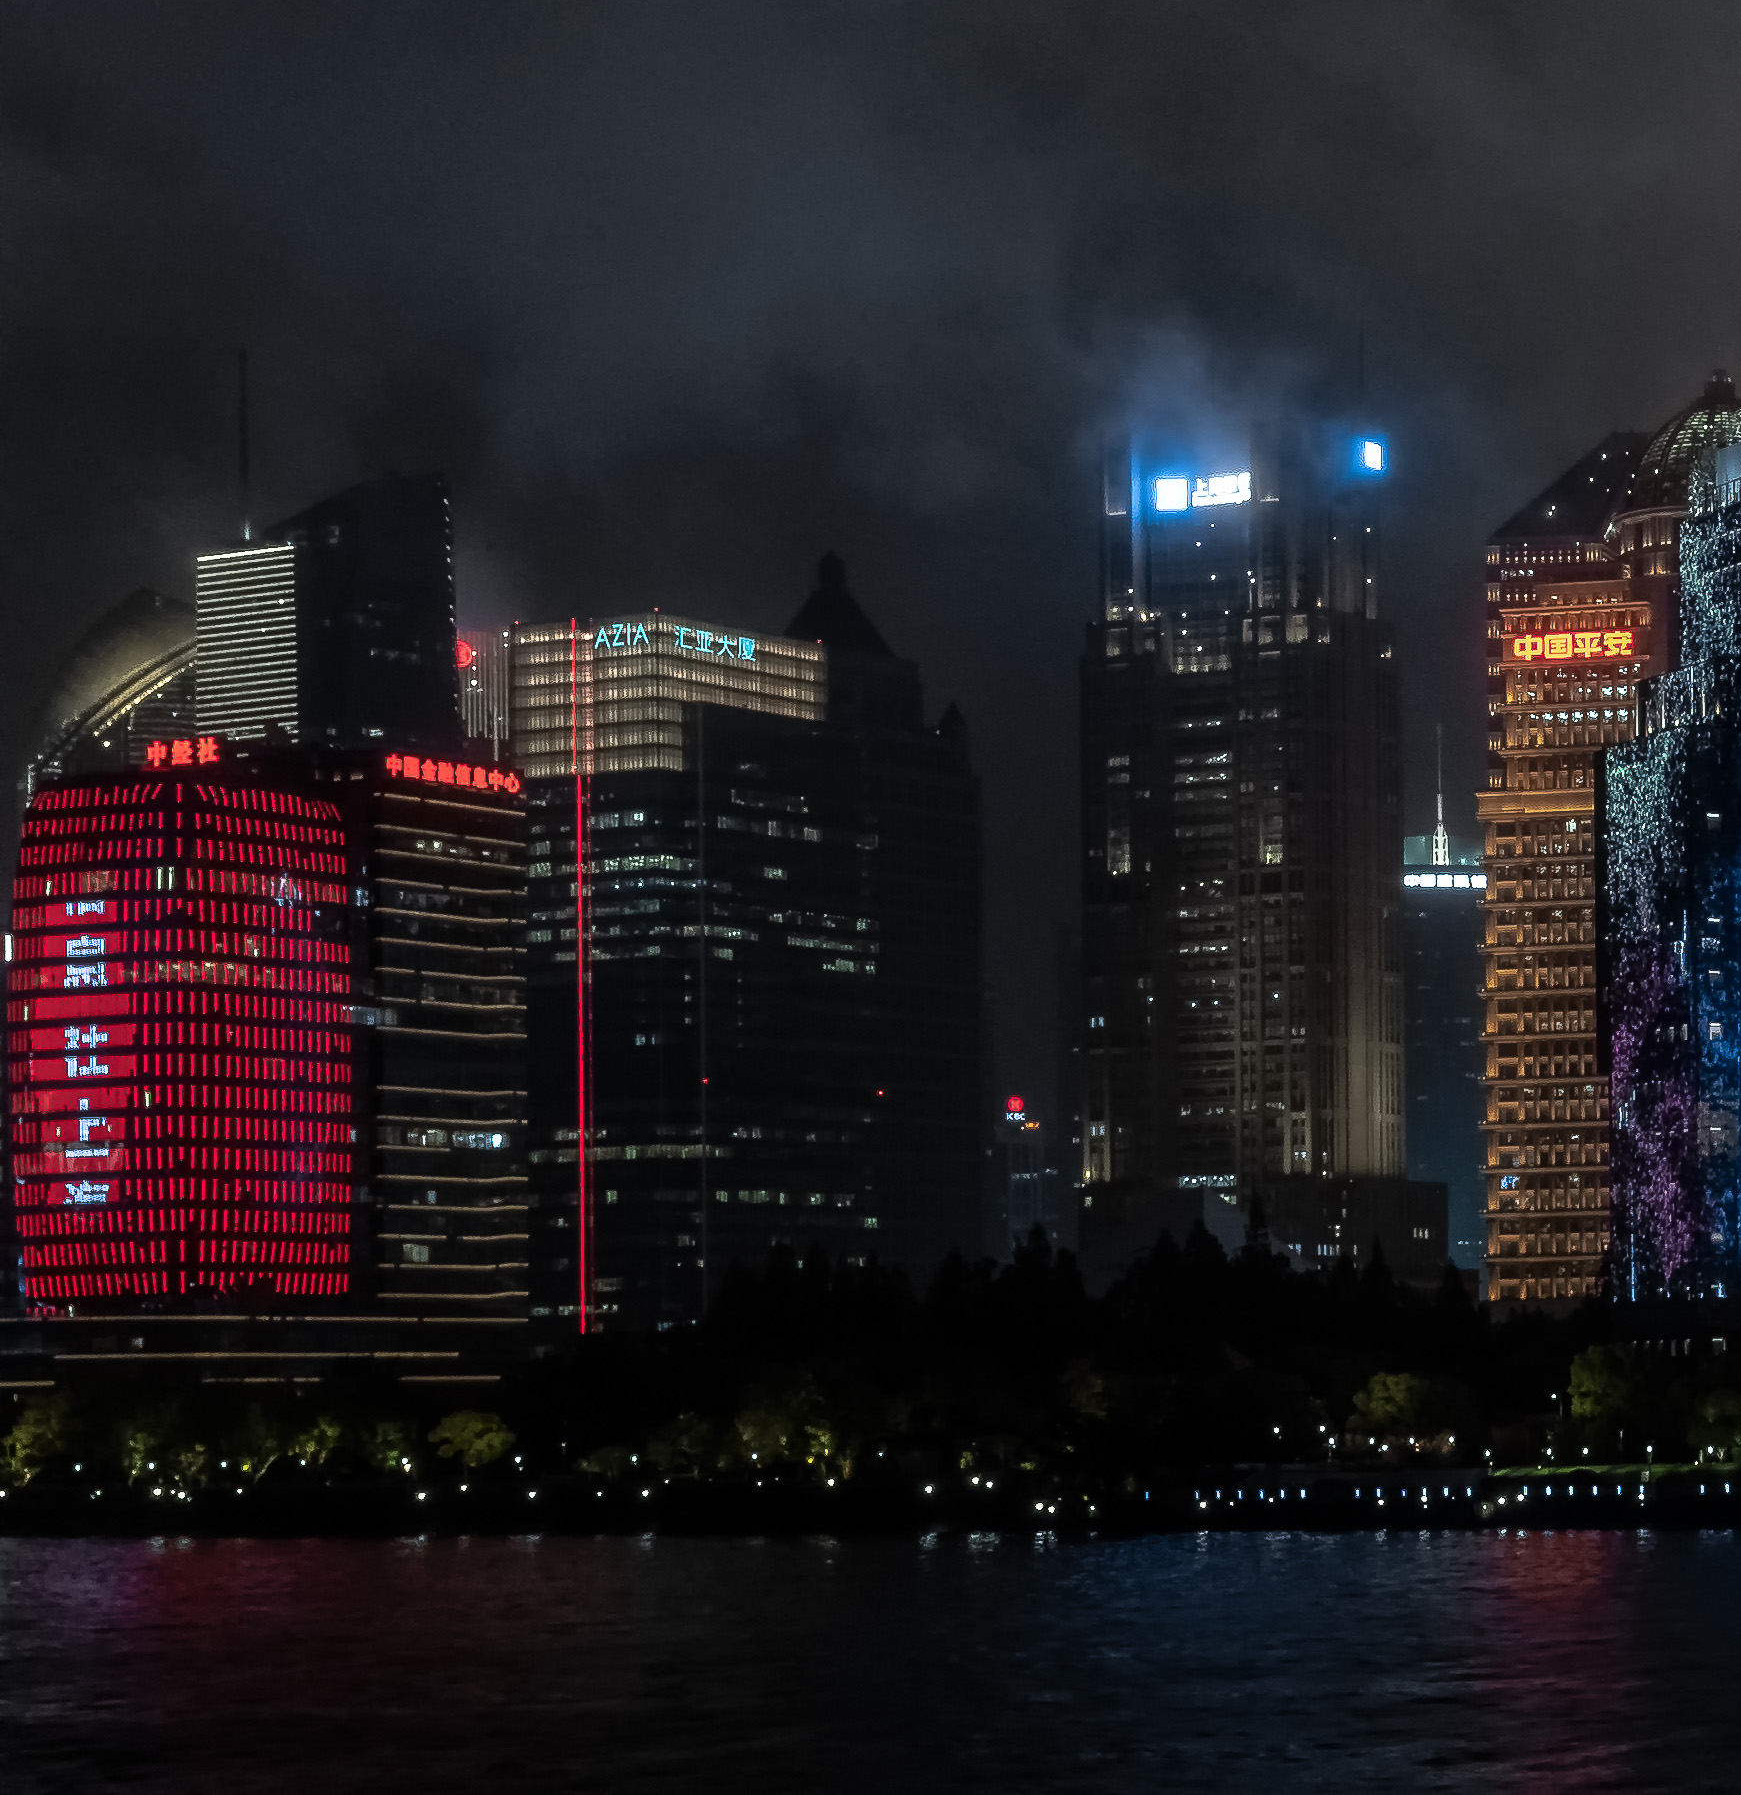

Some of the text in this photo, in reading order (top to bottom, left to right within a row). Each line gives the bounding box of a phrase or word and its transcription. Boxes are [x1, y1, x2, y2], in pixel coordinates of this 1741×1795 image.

[594, 621, 650, 650] AZIA
[674, 625, 758, 661] 汇亚大厦
[1513, 630, 1633, 661] 中国平安
[385, 752, 521, 794] 中国金融信息中心
